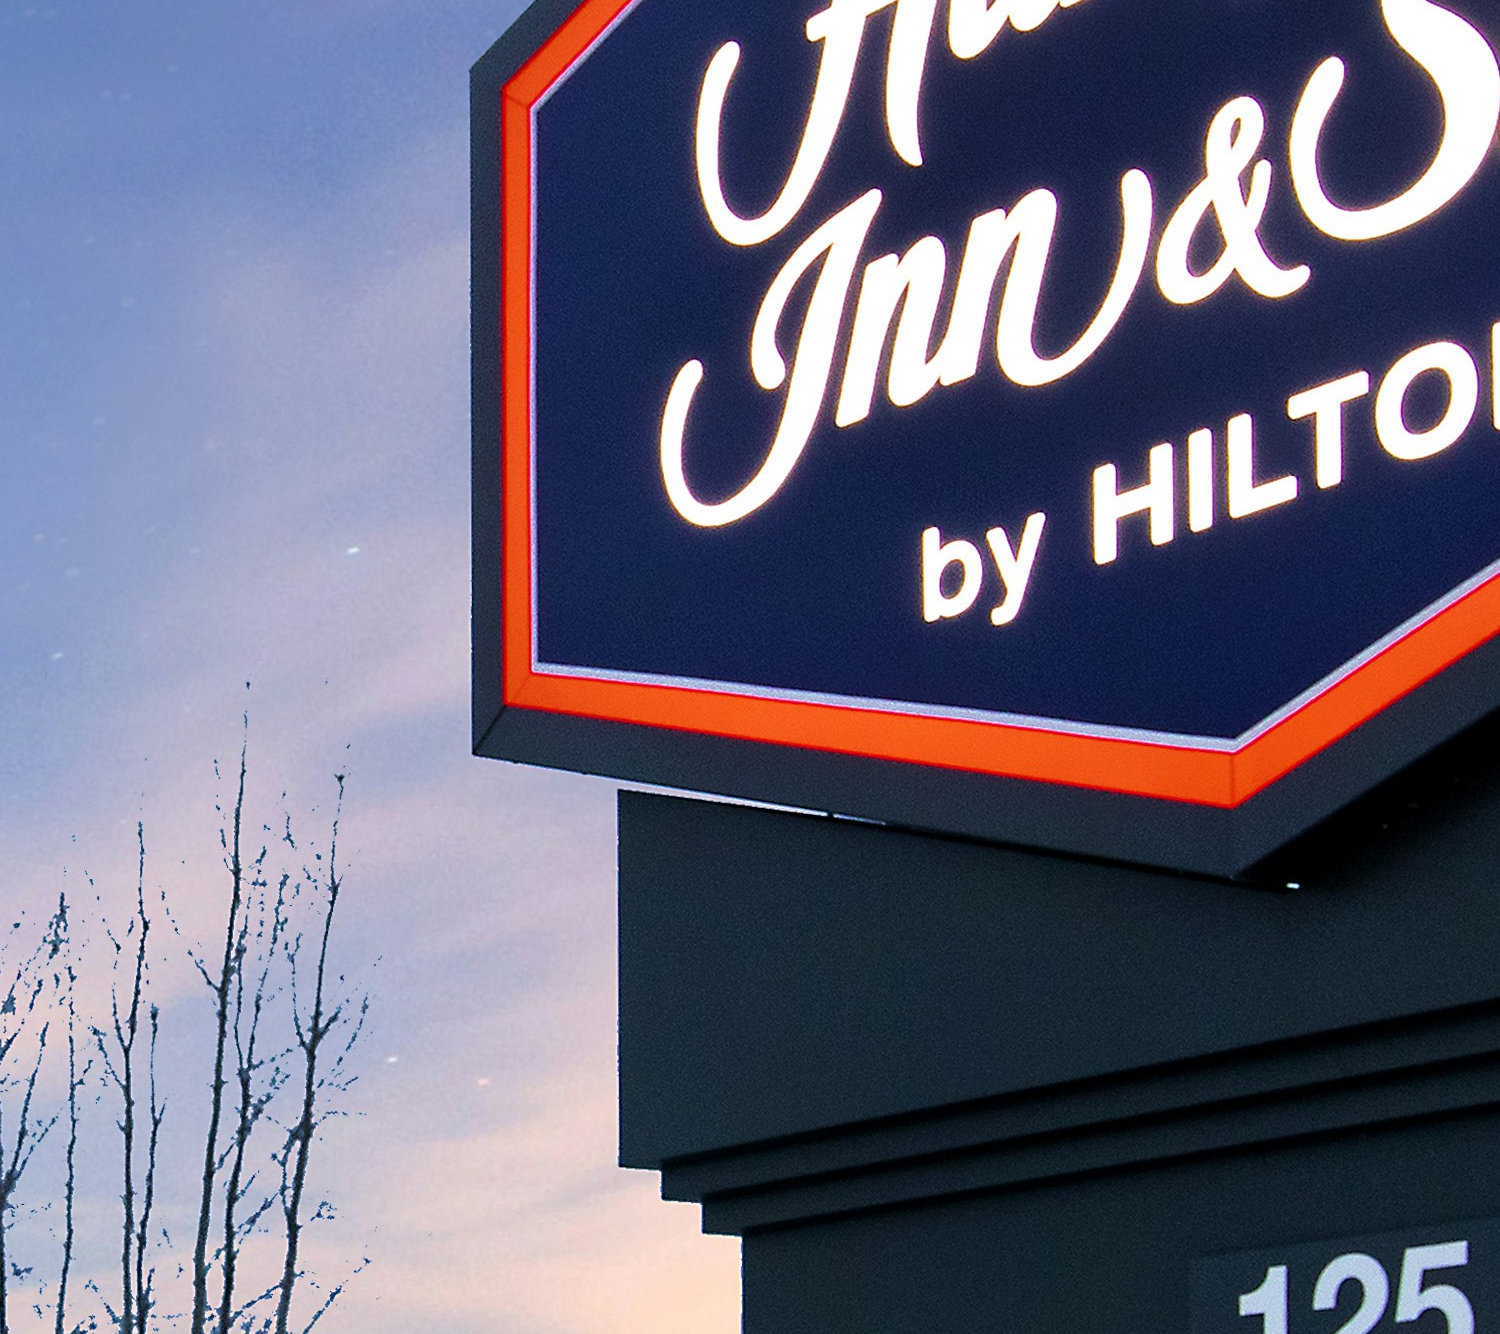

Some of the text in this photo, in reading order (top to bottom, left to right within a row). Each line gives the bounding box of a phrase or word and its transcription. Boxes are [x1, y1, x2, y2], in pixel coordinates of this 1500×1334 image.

[659, 167, 1154, 528] Inn
[1155, 95, 1312, 305] &
[922, 511, 1047, 627] by
